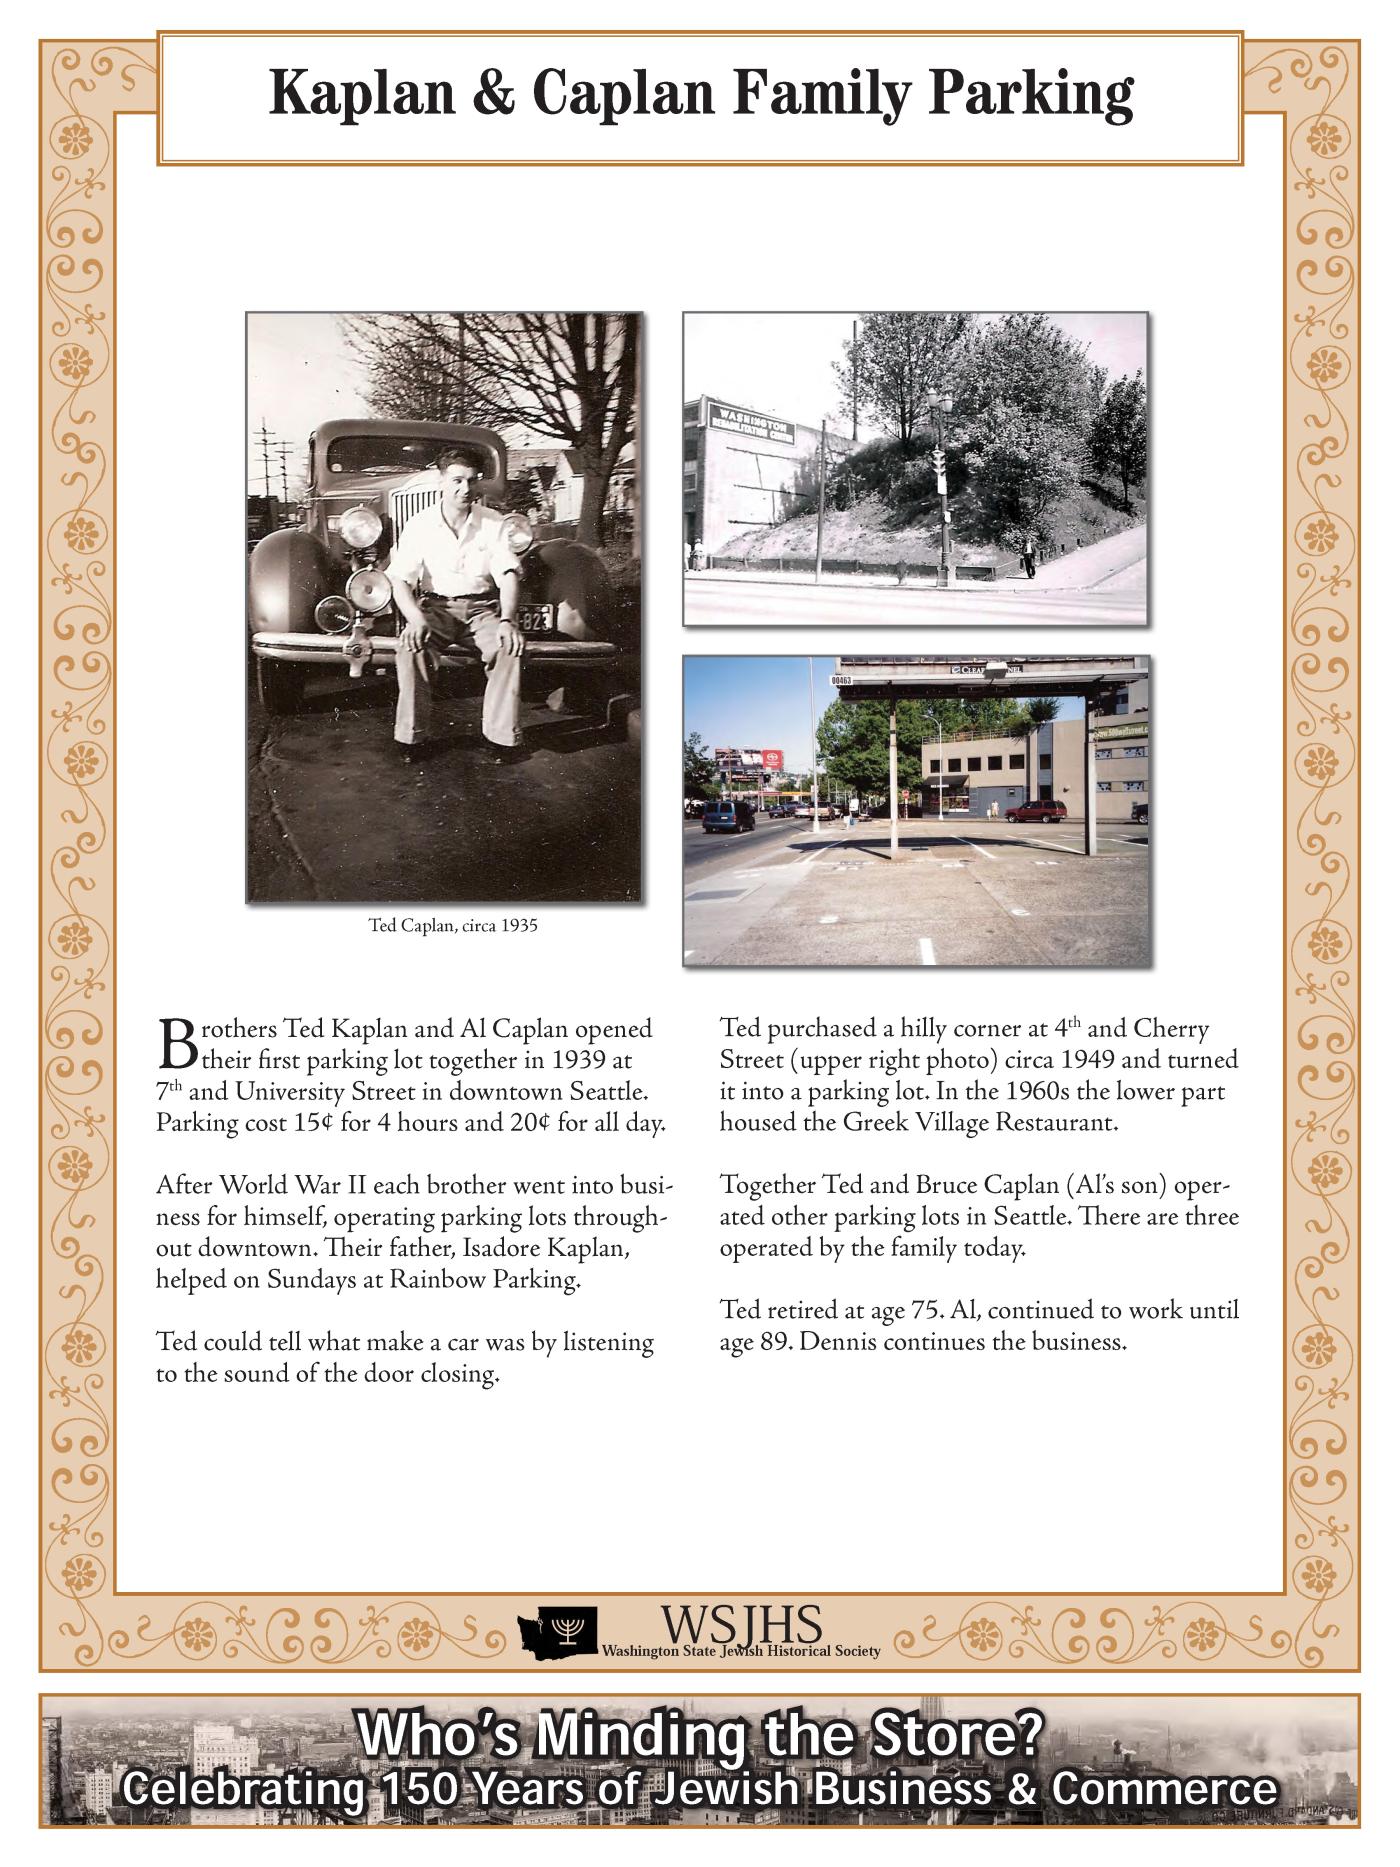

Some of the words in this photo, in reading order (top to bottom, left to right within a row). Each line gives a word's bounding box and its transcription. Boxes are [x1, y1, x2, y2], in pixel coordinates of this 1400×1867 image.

[269, 69, 456, 126] Kaplan
[473, 68, 515, 115] &
[534, 68, 715, 125] Caplan
[733, 68, 912, 126] Family
[929, 68, 1135, 126] Parking
[719, 408, 788, 433] WASHINGTON
[368, 917, 397, 932] Ted
[402, 918, 458, 936] Caplan,
[463, 919, 495, 932] circa
[503, 919, 537, 932] 1935
[283, 1017, 324, 1038] Ted
[332, 1018, 407, 1045] Kaplan
[415, 1017, 454, 1038] and
[460, 1018, 486, 1037] Al
[493, 1017, 568, 1045] Caplan
[576, 1017, 653, 1045] opened
[720, 1016, 761, 1037] Ted
[768, 1016, 877, 1044] purchased
[884, 1025, 894, 1037] a
[901, 1016, 947, 1044] hilly
[954, 1025, 1021, 1037] corner
[1029, 1023, 1048, 1037] at
[1088, 1017, 1127, 1037] and
[1134, 1017, 1209, 1044] Cherry
[202, 1048, 251, 1069] their
[259, 1048, 300, 1069] first
[307, 1048, 388, 1076] parking
[394, 1049, 422, 1069] lot
[430, 1048, 517, 1076] together
[525, 1051, 544, 1068] in
[554, 1050, 605, 1069] 1939
[613, 1055, 632, 1069] at
[721, 1049, 784, 1068] Street
[791, 1048, 862, 1075] (upper
[869, 1048, 920, 1076] right
[926, 1048, 997, 1075] photo)
[1005, 1050, 1054, 1068] circa
[1062, 1050, 1114, 1068] 1949
[1122, 1048, 1161, 1068] and
[1168, 1048, 1239, 1068] turned
[190, 1080, 228, 1100] and
[236, 1081, 345, 1107] University
[353, 1081, 416, 1100] Street
[423, 1082, 442, 1100] in
[450, 1080, 562, 1100] downtown
[571, 1080, 648, 1100] Seattle.
[157, 1111, 239, 1139] Parking
[246, 1118, 287, 1131] cost
[341, 1111, 371, 1131] for
[378, 1113, 391, 1131] 4
[398, 1111, 457, 1131] hours
[465, 1111, 504, 1131] and
[558, 1111, 588, 1131] for
[595, 1111, 619, 1131] all
[626, 1111, 665, 1138] day.
[720, 1110, 797, 1131] housed
[804, 1111, 836, 1131] the
[844, 1111, 909, 1131] Greek
[915, 1111, 989, 1138] Village
[996, 1111, 1118, 1131] Restaurant.
[720, 1173, 816, 1201] Together
[822, 1173, 863, 1194] Ted
[871, 1173, 909, 1193] and
[917, 1174, 977, 1194] Bruce
[984, 1173, 1059, 1201] Caplan
[1122, 1173, 1166, 1199] son)
[1175, 1181, 1230, 1201] oper-
[156, 1243, 192, 1257] out
[199, 1236, 318, 1257] downtown.
[324, 1237, 382, 1257] Their
[390, 1236, 455, 1259] father,
[463, 1236, 540, 1257] Isadore
[548, 1237, 629, 1264] Kaplan,
[720, 1236, 813, 1263] operated
[820, 1236, 845, 1263] by
[852, 1236, 884, 1256] the
[892, 1236, 957, 1263] family
[964, 1236, 1026, 1263] today.
[156, 1268, 227, 1295] helped
[234, 1276, 260, 1288] on
[268, 1268, 356, 1295] Sundays
[364, 1275, 383, 1288] at
[390, 1268, 486, 1288] Rainbow
[493, 1268, 581, 1295] Parking.
[720, 1298, 761, 1319] Ted
[768, 1299, 838, 1319] retired
[845, 1305, 864, 1319] at
[872, 1307, 905, 1326] age
[912, 1300, 944, 1319] 75.
[950, 1299, 981, 1321] Al,
[988, 1299, 1094, 1319] continued
[1101, 1305, 1121, 1319] to
[1129, 1298, 1183, 1319] work
[1190, 1299, 1239, 1319] until
[156, 1330, 197, 1351] Ted
[204, 1330, 262, 1351] could
[269, 1331, 301, 1351] tell
[308, 1330, 360, 1351] what
[367, 1330, 423, 1351] make
[431, 1339, 441, 1351] a
[448, 1339, 479, 1351] car
[486, 1339, 524, 1351] was
[532, 1330, 557, 1358] by
[564, 1331, 654, 1358] listening
[720, 1338, 754, 1358] age
[761, 1332, 793, 1350] 89.
[800, 1331, 876, 1350] Dennis
[884, 1332, 985, 1350] continues
[993, 1330, 1026, 1350] the
[1032, 1330, 1127, 1350] business.
[157, 1369, 177, 1382] to
[185, 1362, 218, 1382] the
[225, 1362, 289, 1382] sound
[297, 1362, 320, 1382] of
[325, 1362, 358, 1382] the
[365, 1362, 414, 1382] door
[421, 1362, 499, 1390] closing.
[661, 1605, 823, 1650] WSJHS
[602, 1645, 679, 1660] Washington
[684, 1645, 716, 1657] State
[720, 1644, 763, 1658] Jewish
[767, 1645, 831, 1657] Historical
[836, 1645, 881, 1660] Society
[539, 1712, 745, 1770] Minding
[765, 1713, 854, 1756] the
[874, 1712, 1044, 1756] Store?
[123, 1771, 363, 1815] Celebrating
[382, 1771, 458, 1805] 150
[472, 1771, 584, 1805] Years
[599, 1771, 641, 1805] of
[655, 1771, 798, 1805] Jewish
[816, 1771, 991, 1805] Business
[1008, 1773, 1036, 1805] &
[1053, 1771, 1278, 1805] Commerce
